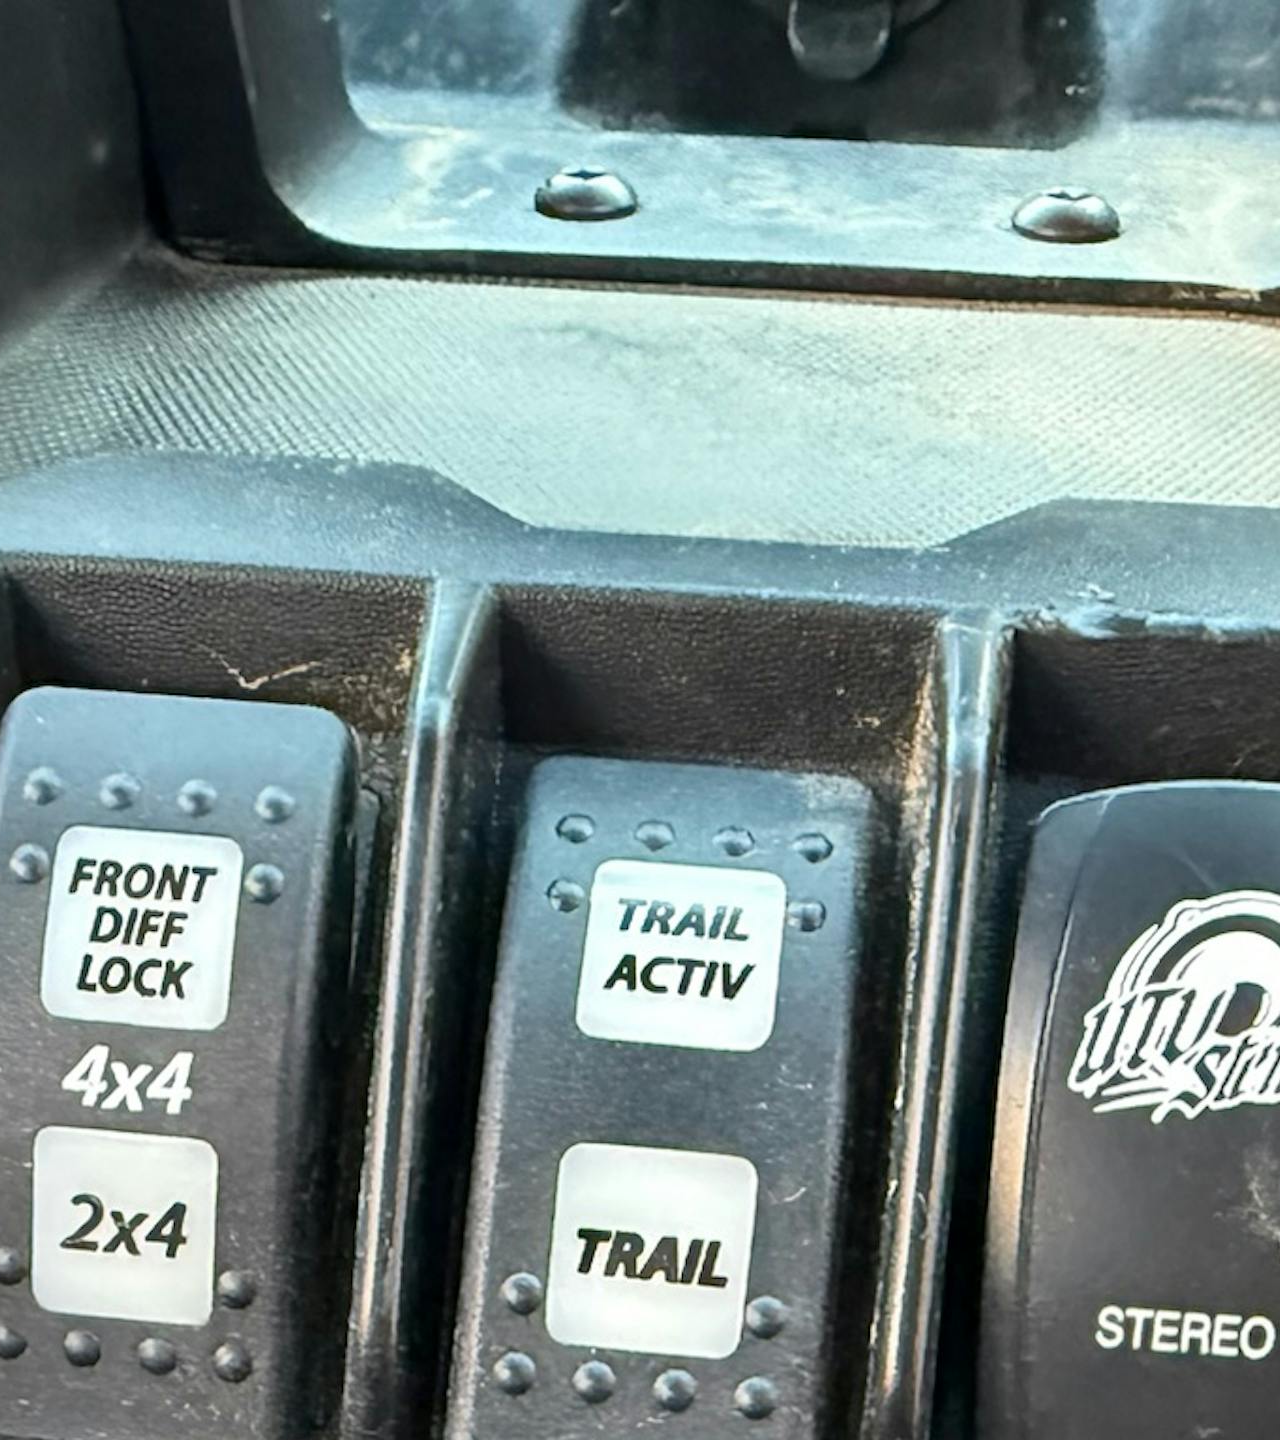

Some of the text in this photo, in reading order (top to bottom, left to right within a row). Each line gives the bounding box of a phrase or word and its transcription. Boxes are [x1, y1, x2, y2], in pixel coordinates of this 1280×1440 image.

[68, 858, 217, 903] FRONT
[90, 908, 188, 949] DIFF
[618, 898, 751, 943] TRAIL
[76, 954, 194, 1000] LOCK
[603, 954, 756, 1001] ACTIV
[61, 1044, 195, 1115] 4x4
[59, 1194, 190, 1260] 2x4
[576, 1227, 729, 1289] TRAIL
[1094, 1305, 1277, 1361] STEREO
